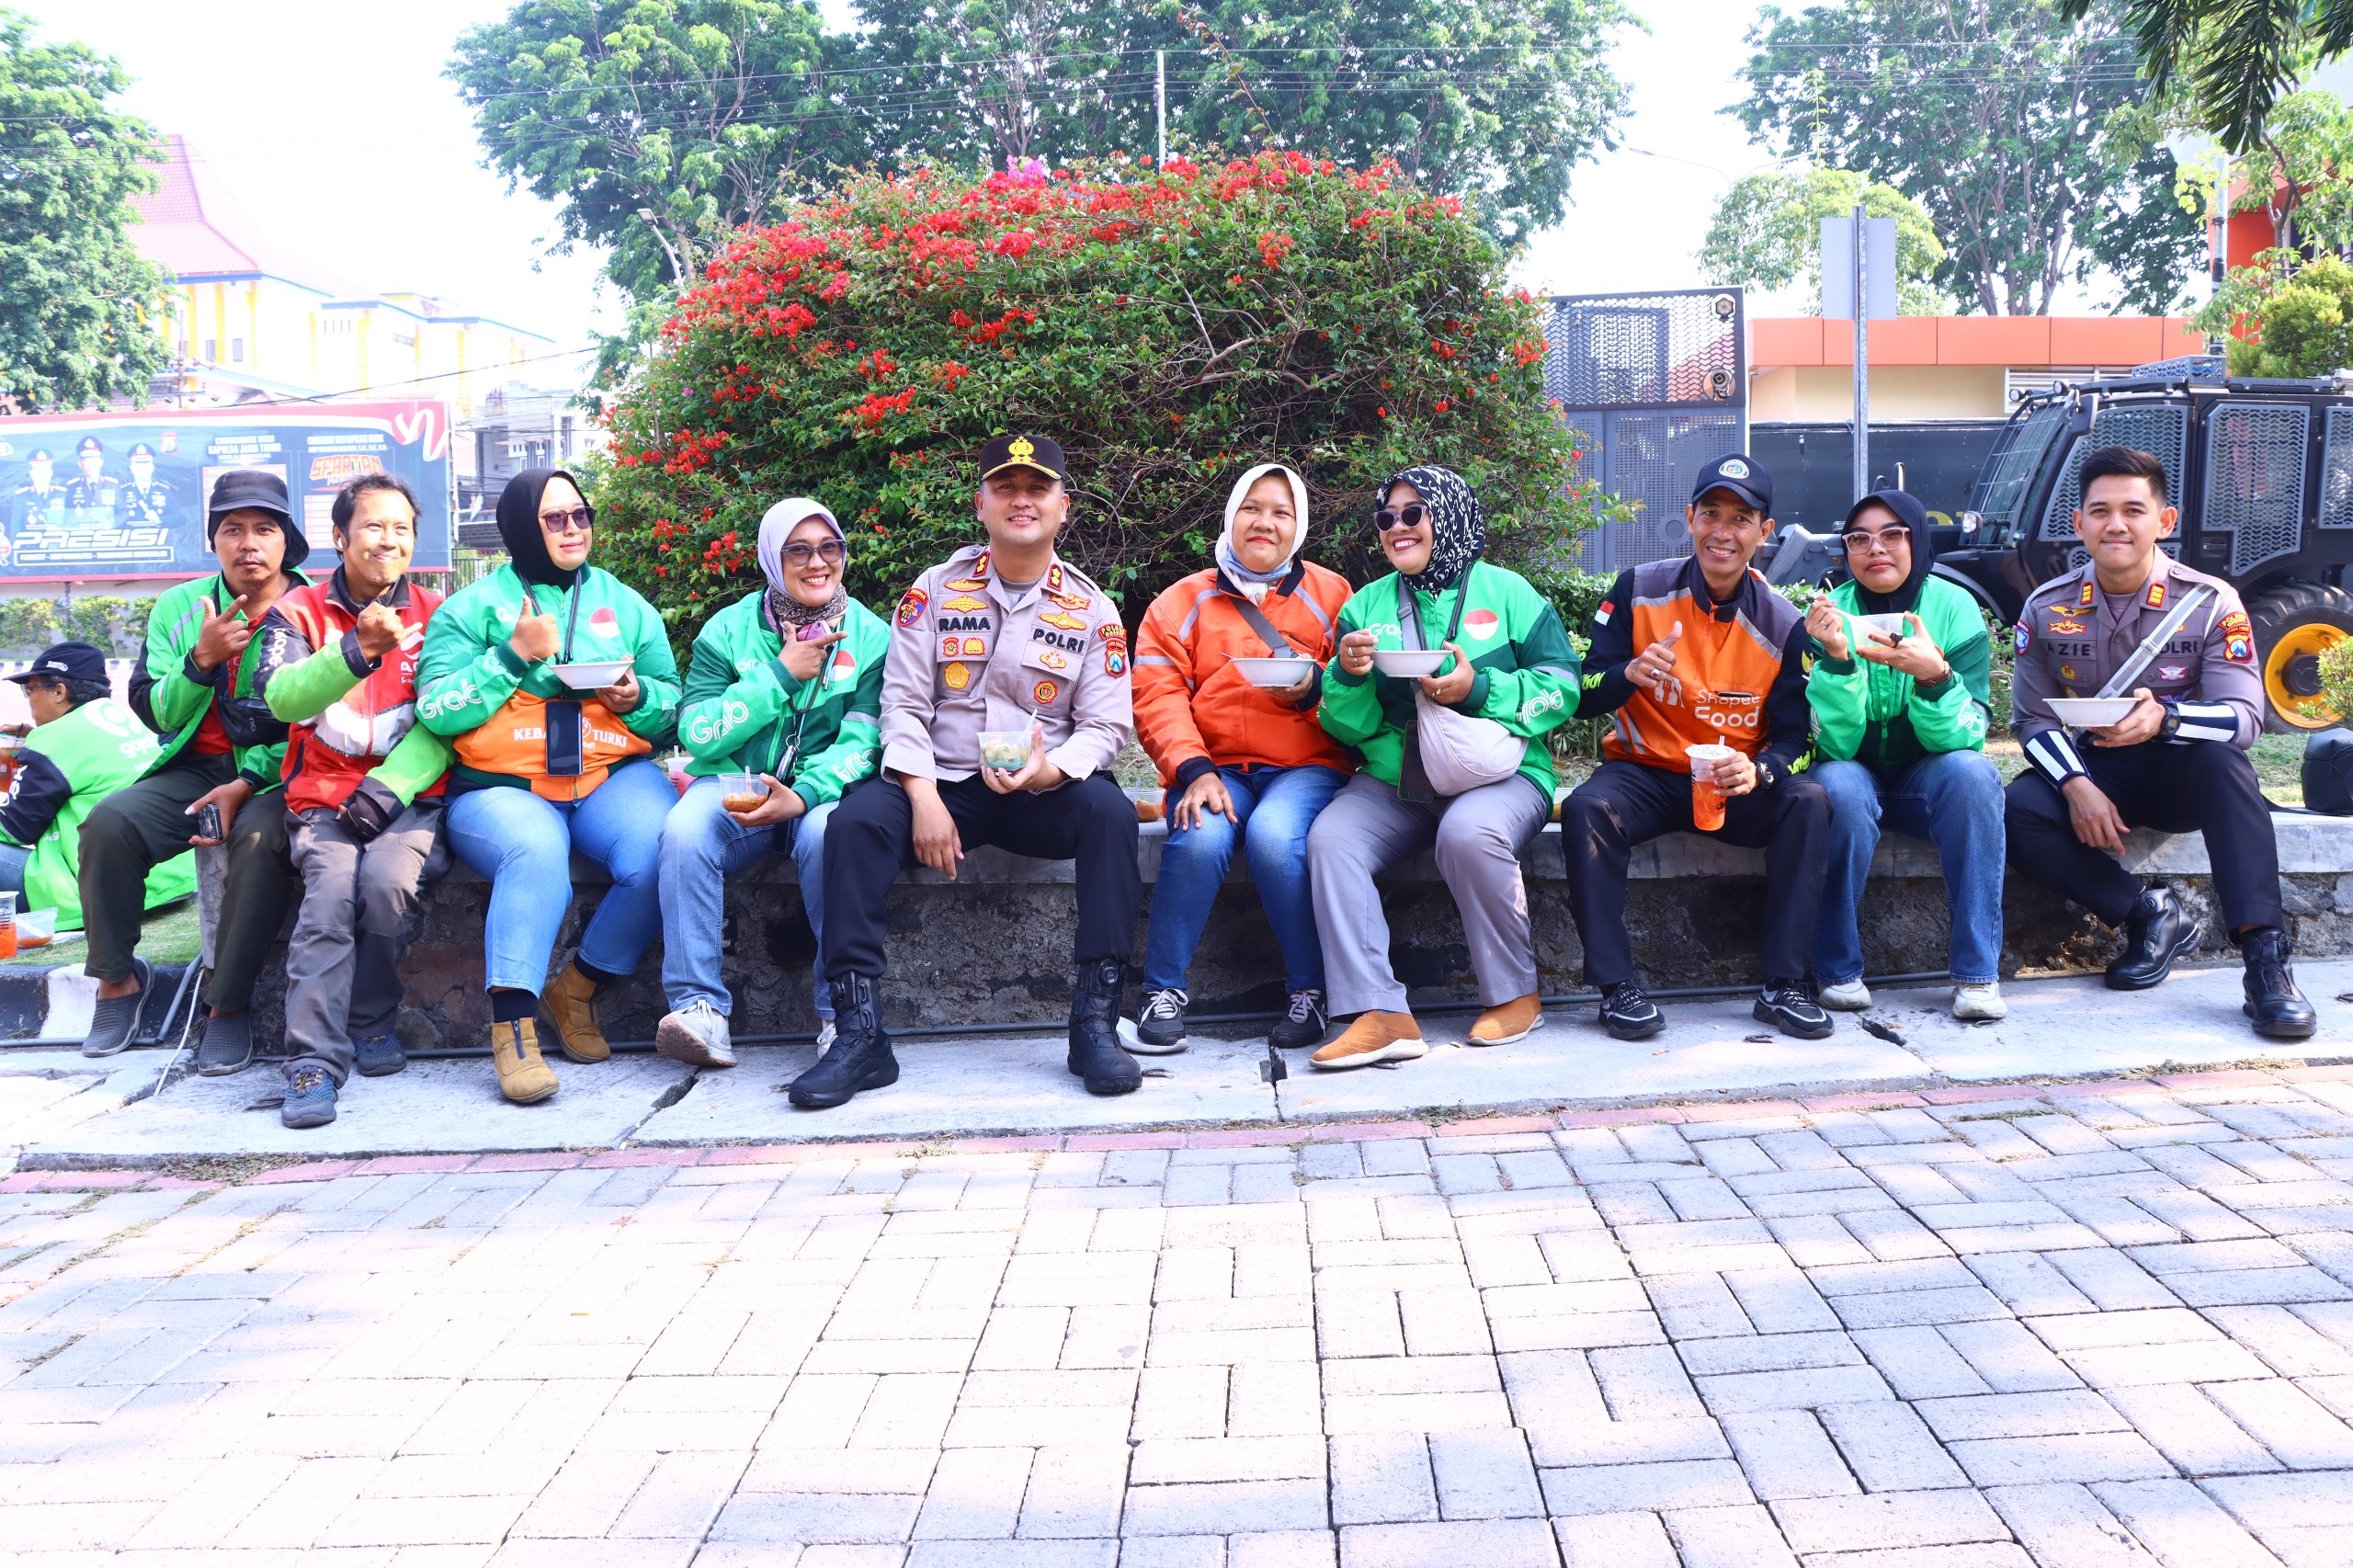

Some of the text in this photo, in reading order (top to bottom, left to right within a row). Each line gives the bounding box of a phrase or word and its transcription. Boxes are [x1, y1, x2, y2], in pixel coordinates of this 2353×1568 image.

[208, 445, 239, 454] KAPOLDA
[240, 444, 259, 453] JAWA
[13, 528, 169, 550] PRESISI
[938, 616, 992, 632] RAMA
[1033, 628, 1086, 653] POLRI
[2160, 641, 2199, 654] OLRI
[417, 678, 483, 719] Grab
[1696, 689, 1760, 709] Shopee
[1695, 707, 1760, 727] Food
[513, 727, 629, 748] KEB TURKI
